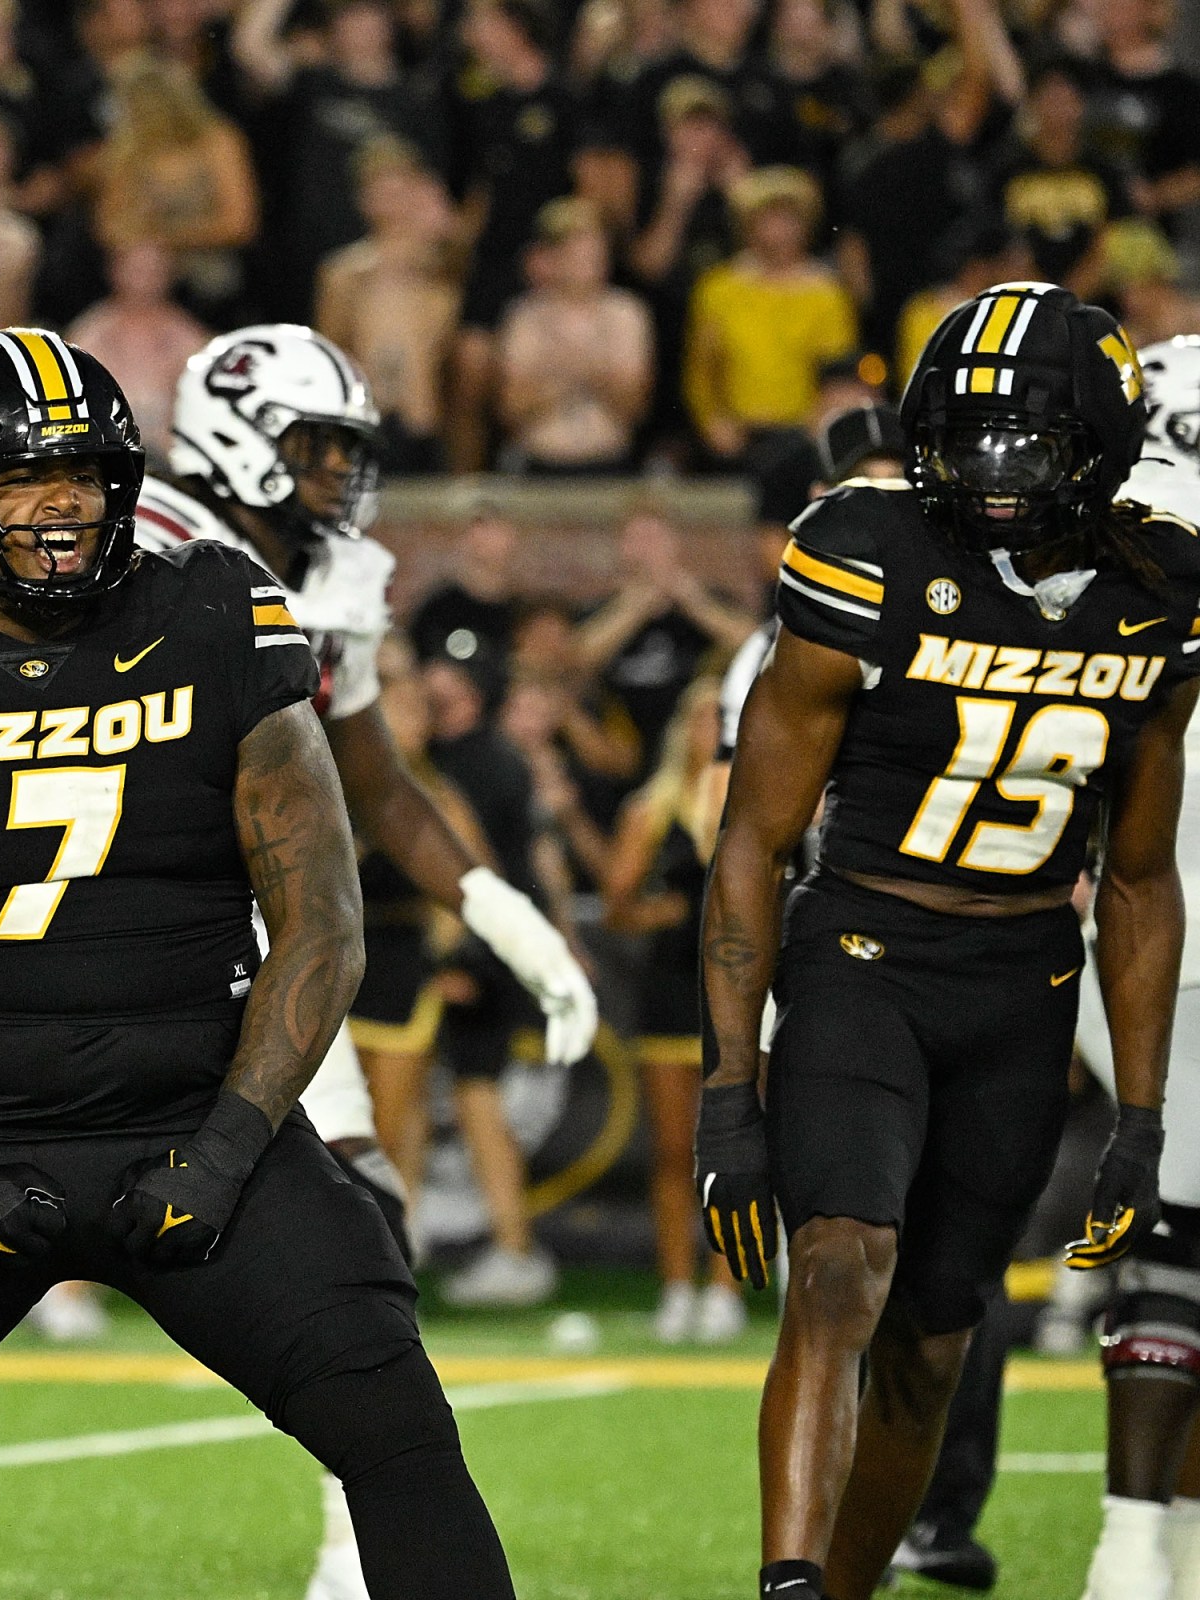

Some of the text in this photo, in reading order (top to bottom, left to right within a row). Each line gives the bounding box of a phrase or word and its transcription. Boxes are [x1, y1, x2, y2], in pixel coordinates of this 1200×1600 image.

[41, 423, 89, 437] MIZZOU
[929, 580, 958, 612] SEC
[905, 633, 1167, 701] MIZZOU
[898, 696, 1110, 875] 19
[233, 963, 247, 978] XL
